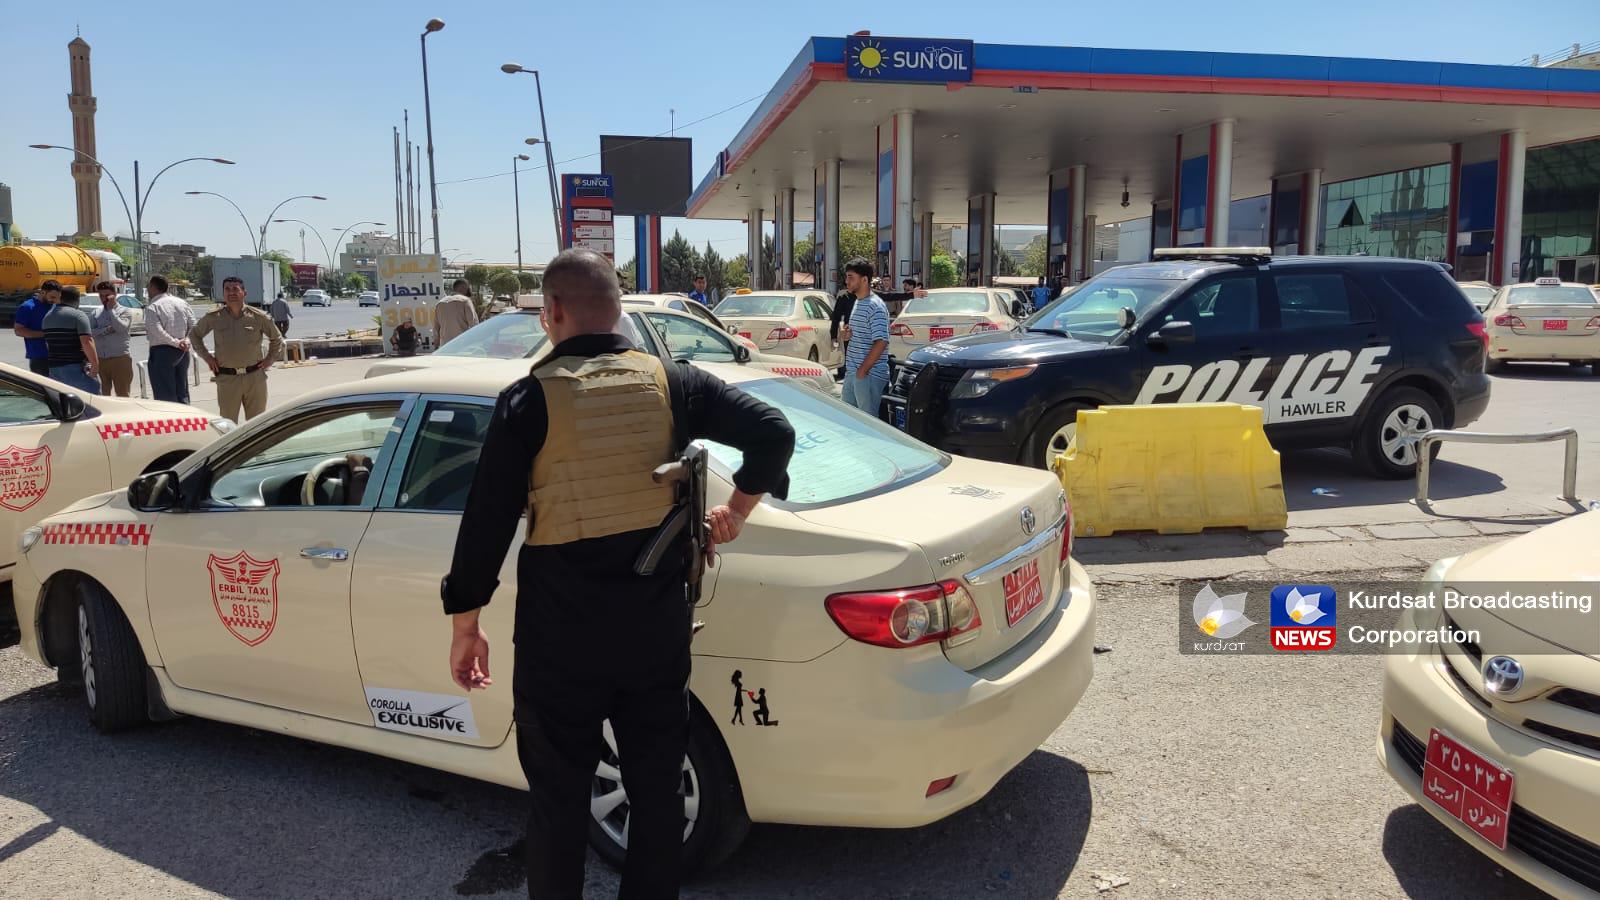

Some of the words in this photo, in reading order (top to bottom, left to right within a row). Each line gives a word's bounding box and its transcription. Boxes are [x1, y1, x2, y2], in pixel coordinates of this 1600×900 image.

[893, 52, 933, 70] SUN
[938, 53, 967, 71] OIL
[1133, 346, 1391, 405] POLICE
[1281, 401, 1346, 417] HAWLER
[0, 469, 19, 477] RBIL
[22, 465, 43, 473] TAXI
[3, 480, 37, 493] 12125
[219, 584, 244, 594] ERBIL
[248, 586, 269, 595] TAXI
[232, 603, 260, 619] 8815
[371, 698, 412, 712] COROLLA
[378, 711, 466, 733] EXCLUSIVE
